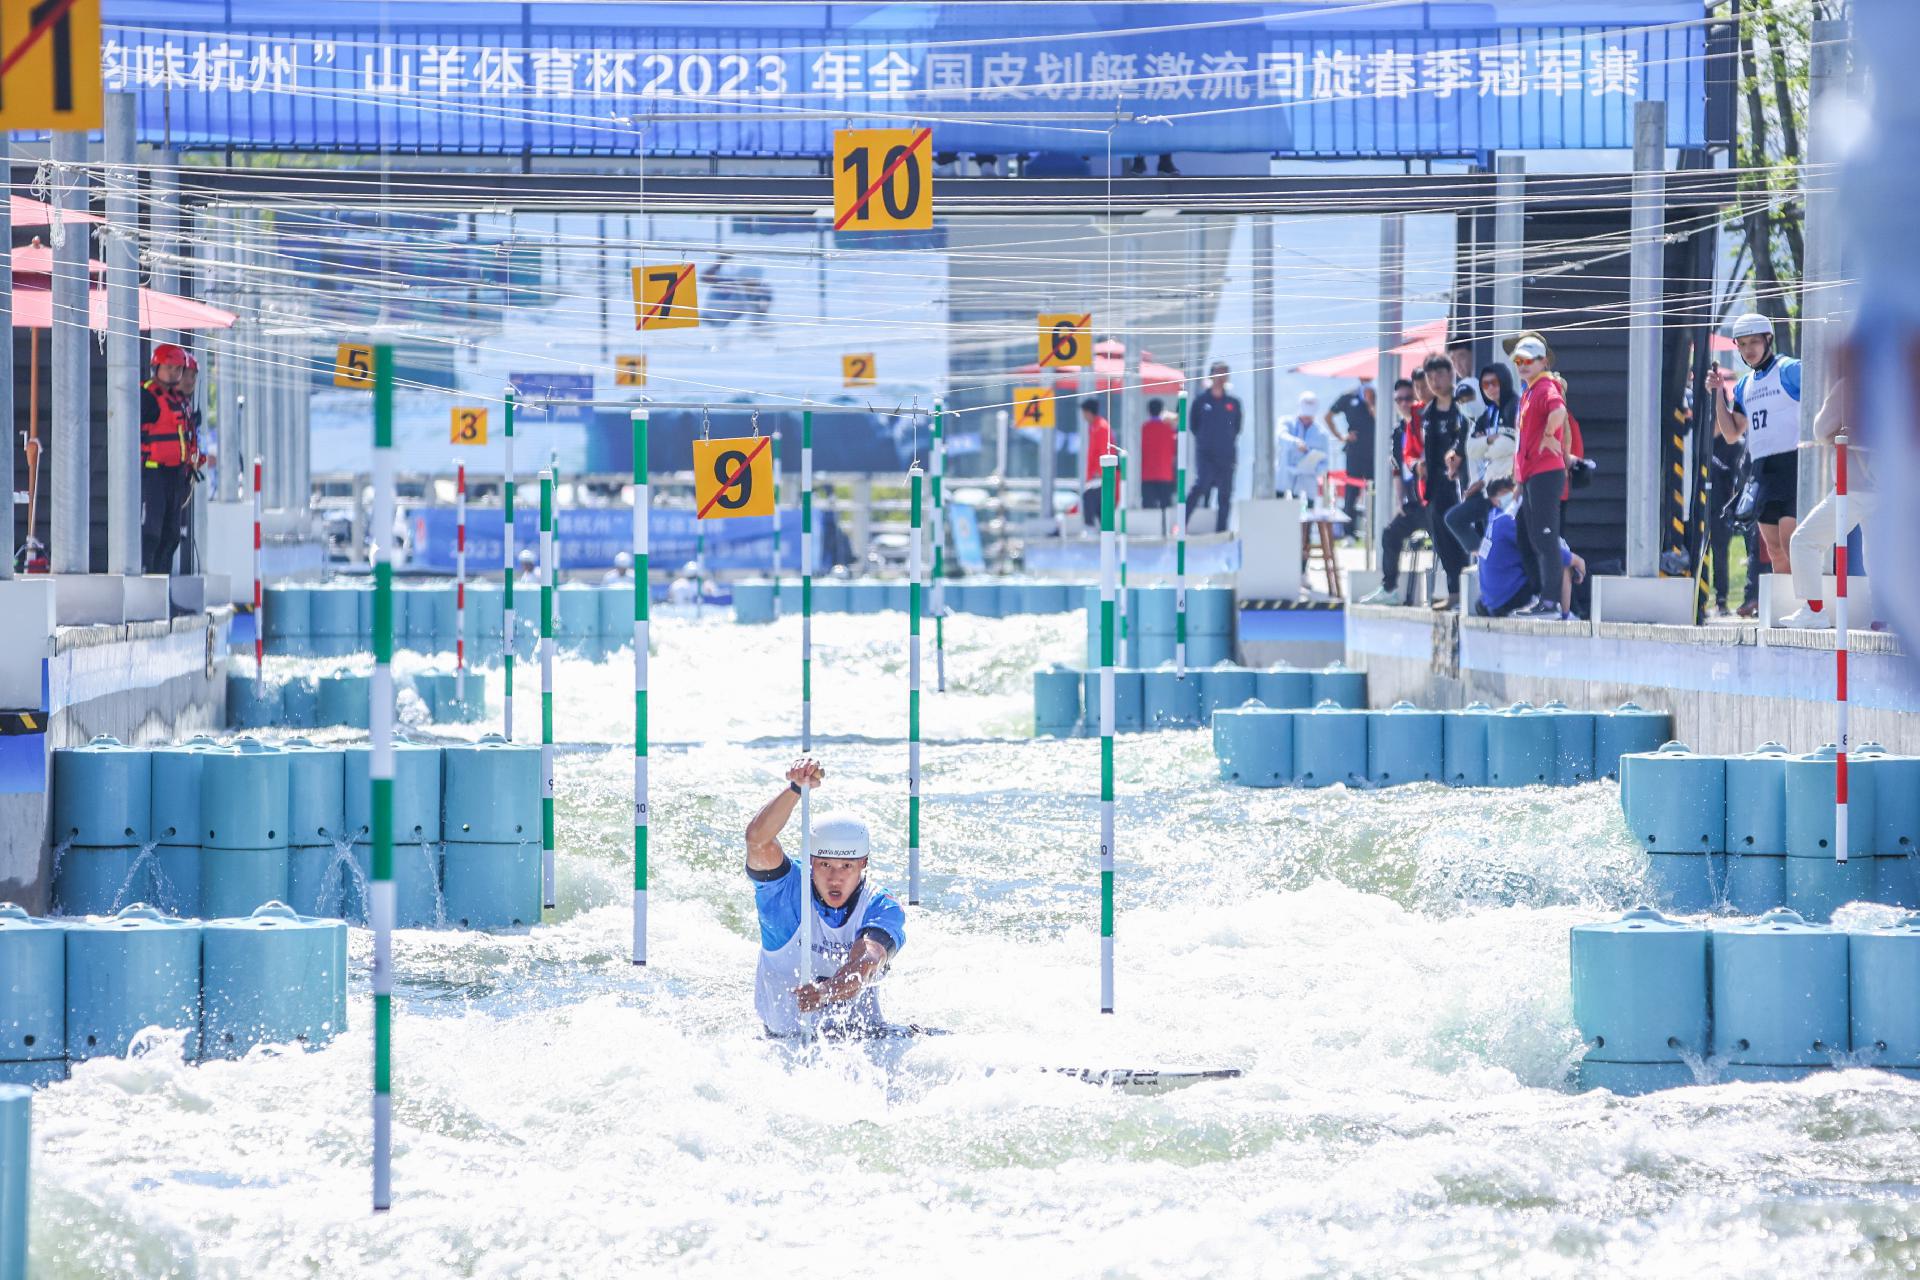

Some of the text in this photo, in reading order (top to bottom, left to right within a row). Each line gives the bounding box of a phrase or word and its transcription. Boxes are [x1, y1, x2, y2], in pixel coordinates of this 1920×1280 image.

[0, 0, 73, 113] 1
[843, 145, 920, 220] 10
[648, 272, 678, 320] 7
[1051, 321, 1077, 360] 6
[348, 350, 369, 382] 5
[460, 412, 477, 440] 3
[1023, 395, 1042, 422] 4
[1752, 409, 1768, 431] 67
[714, 451, 753, 509] 9
[635, 803, 646, 814] 10
